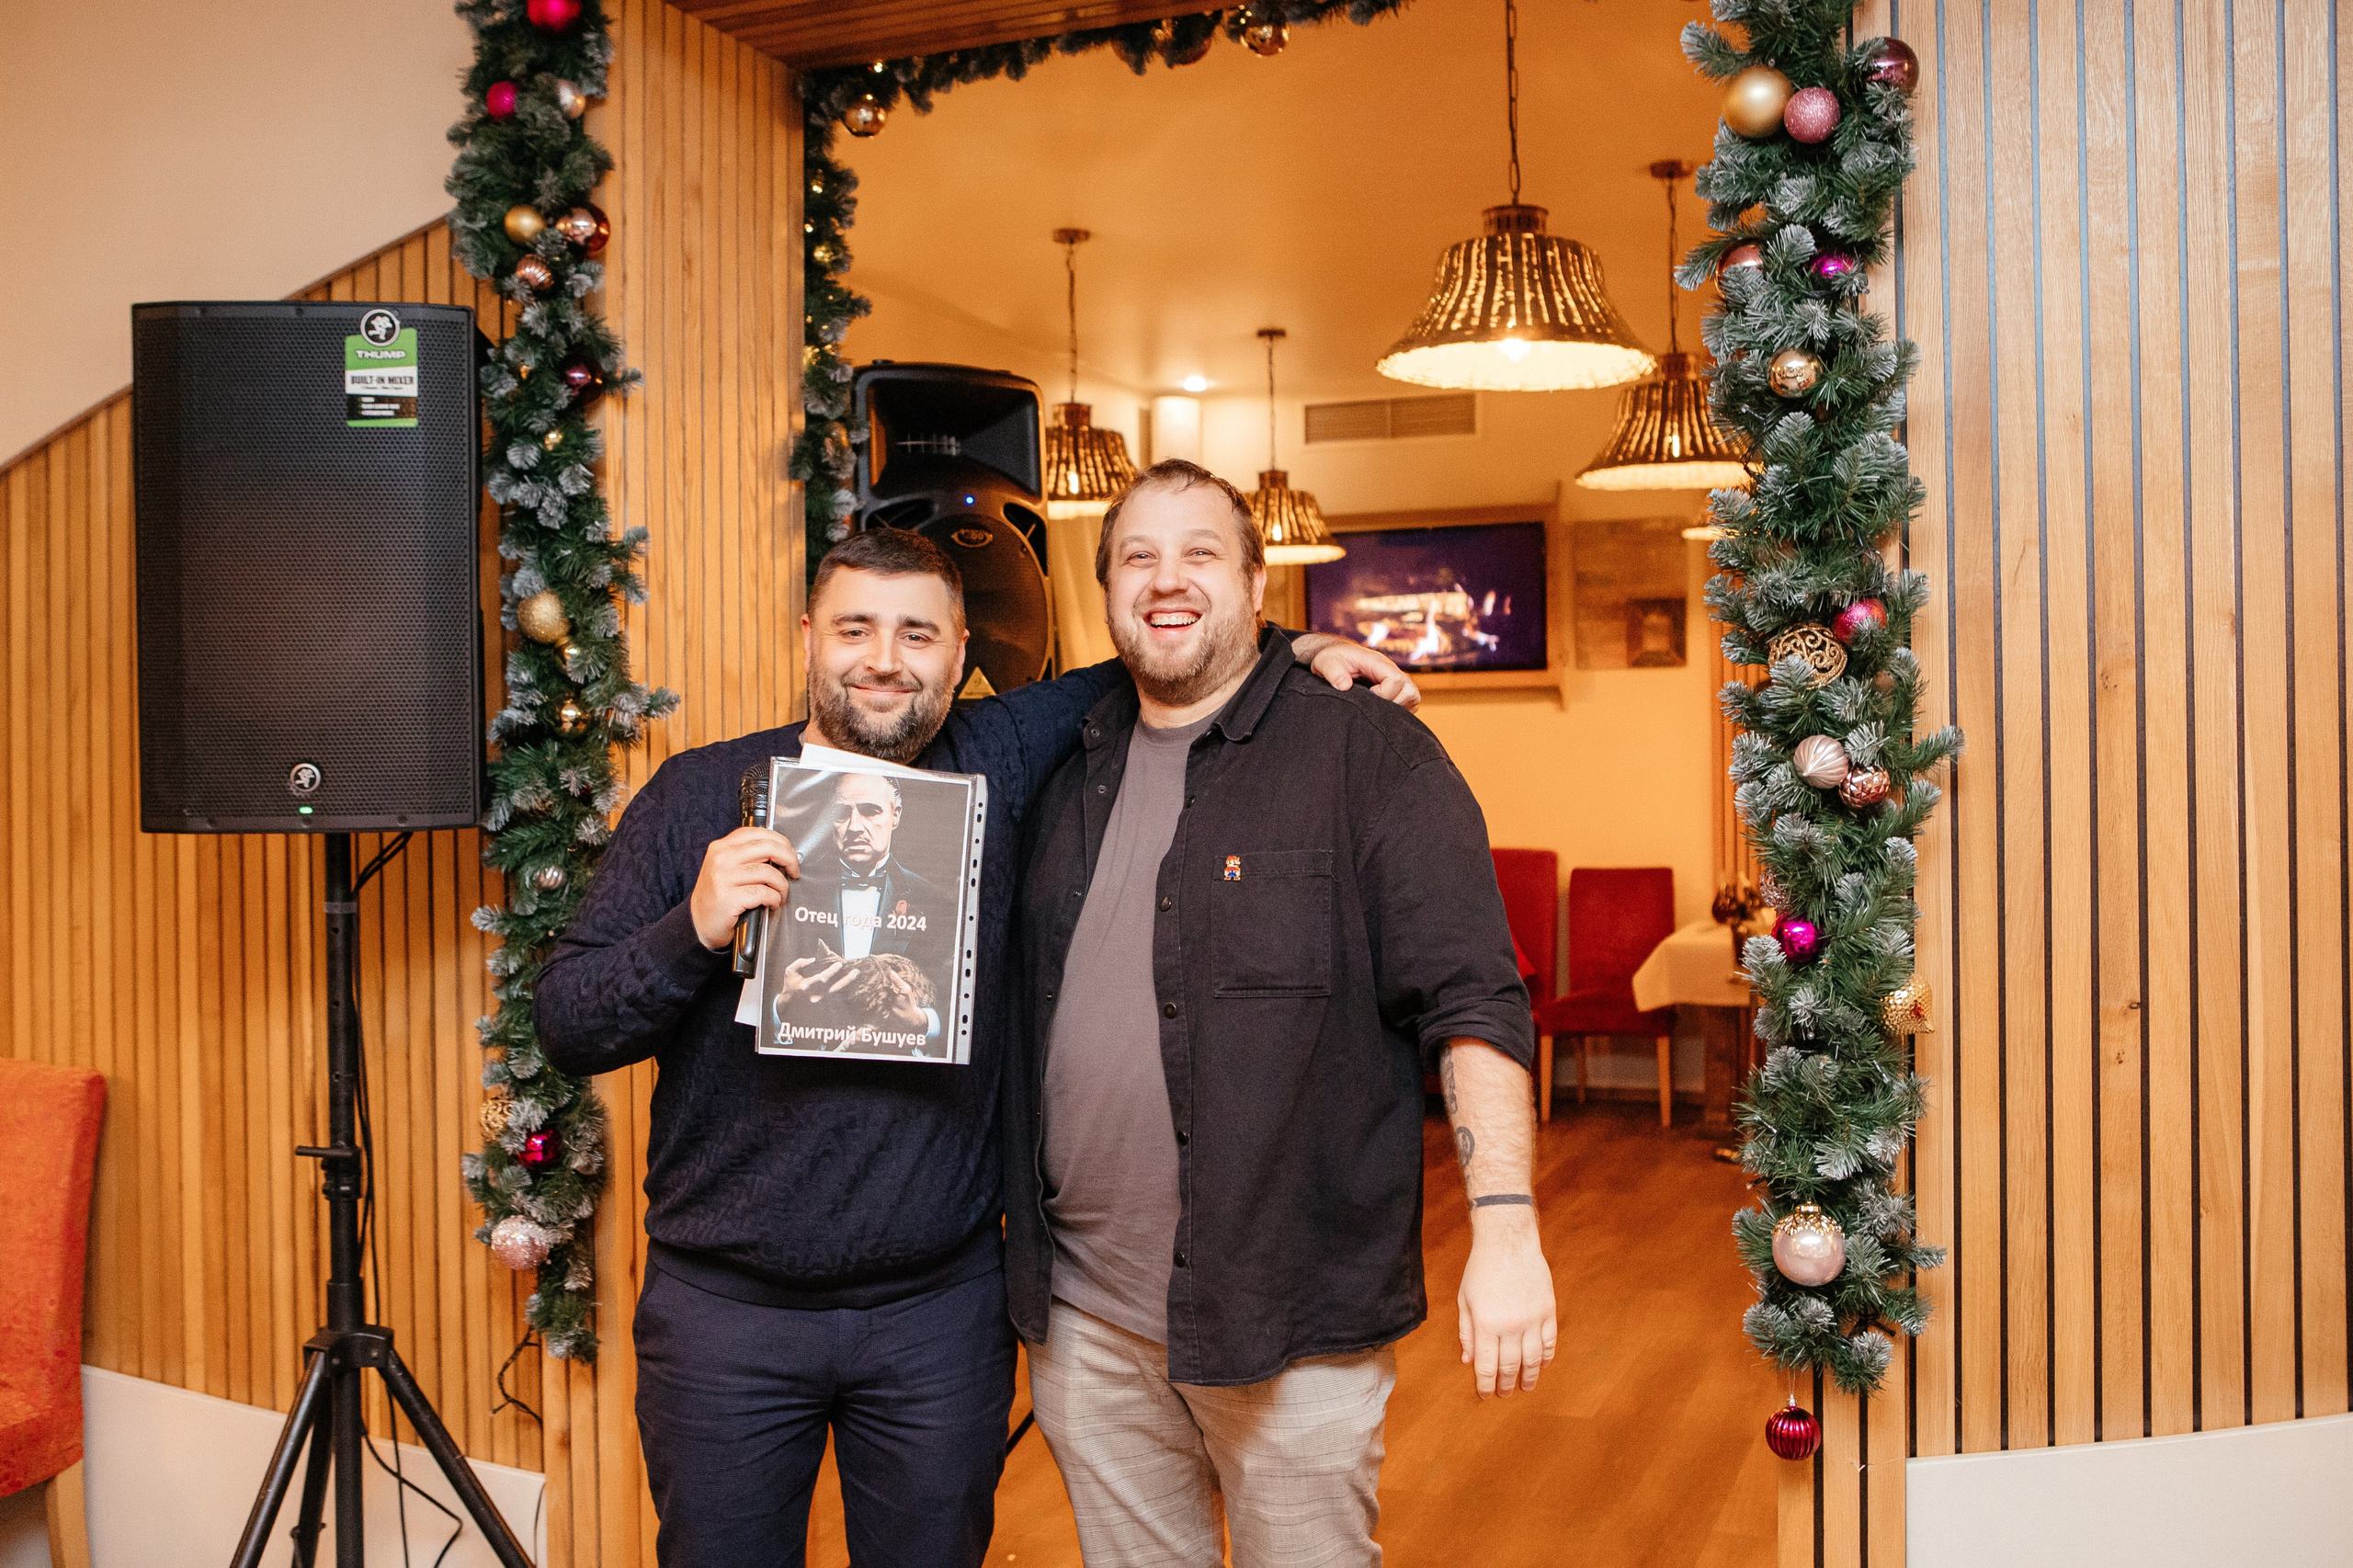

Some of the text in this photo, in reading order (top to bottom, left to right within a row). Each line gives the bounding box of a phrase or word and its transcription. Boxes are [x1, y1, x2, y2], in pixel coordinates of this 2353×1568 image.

[356, 350, 406, 358] THUMP
[388, 376, 414, 384] MIXER
[794, 906, 927, 931] Отец года 2024
[778, 1022, 926, 1048] Дмитрий Бушуев
